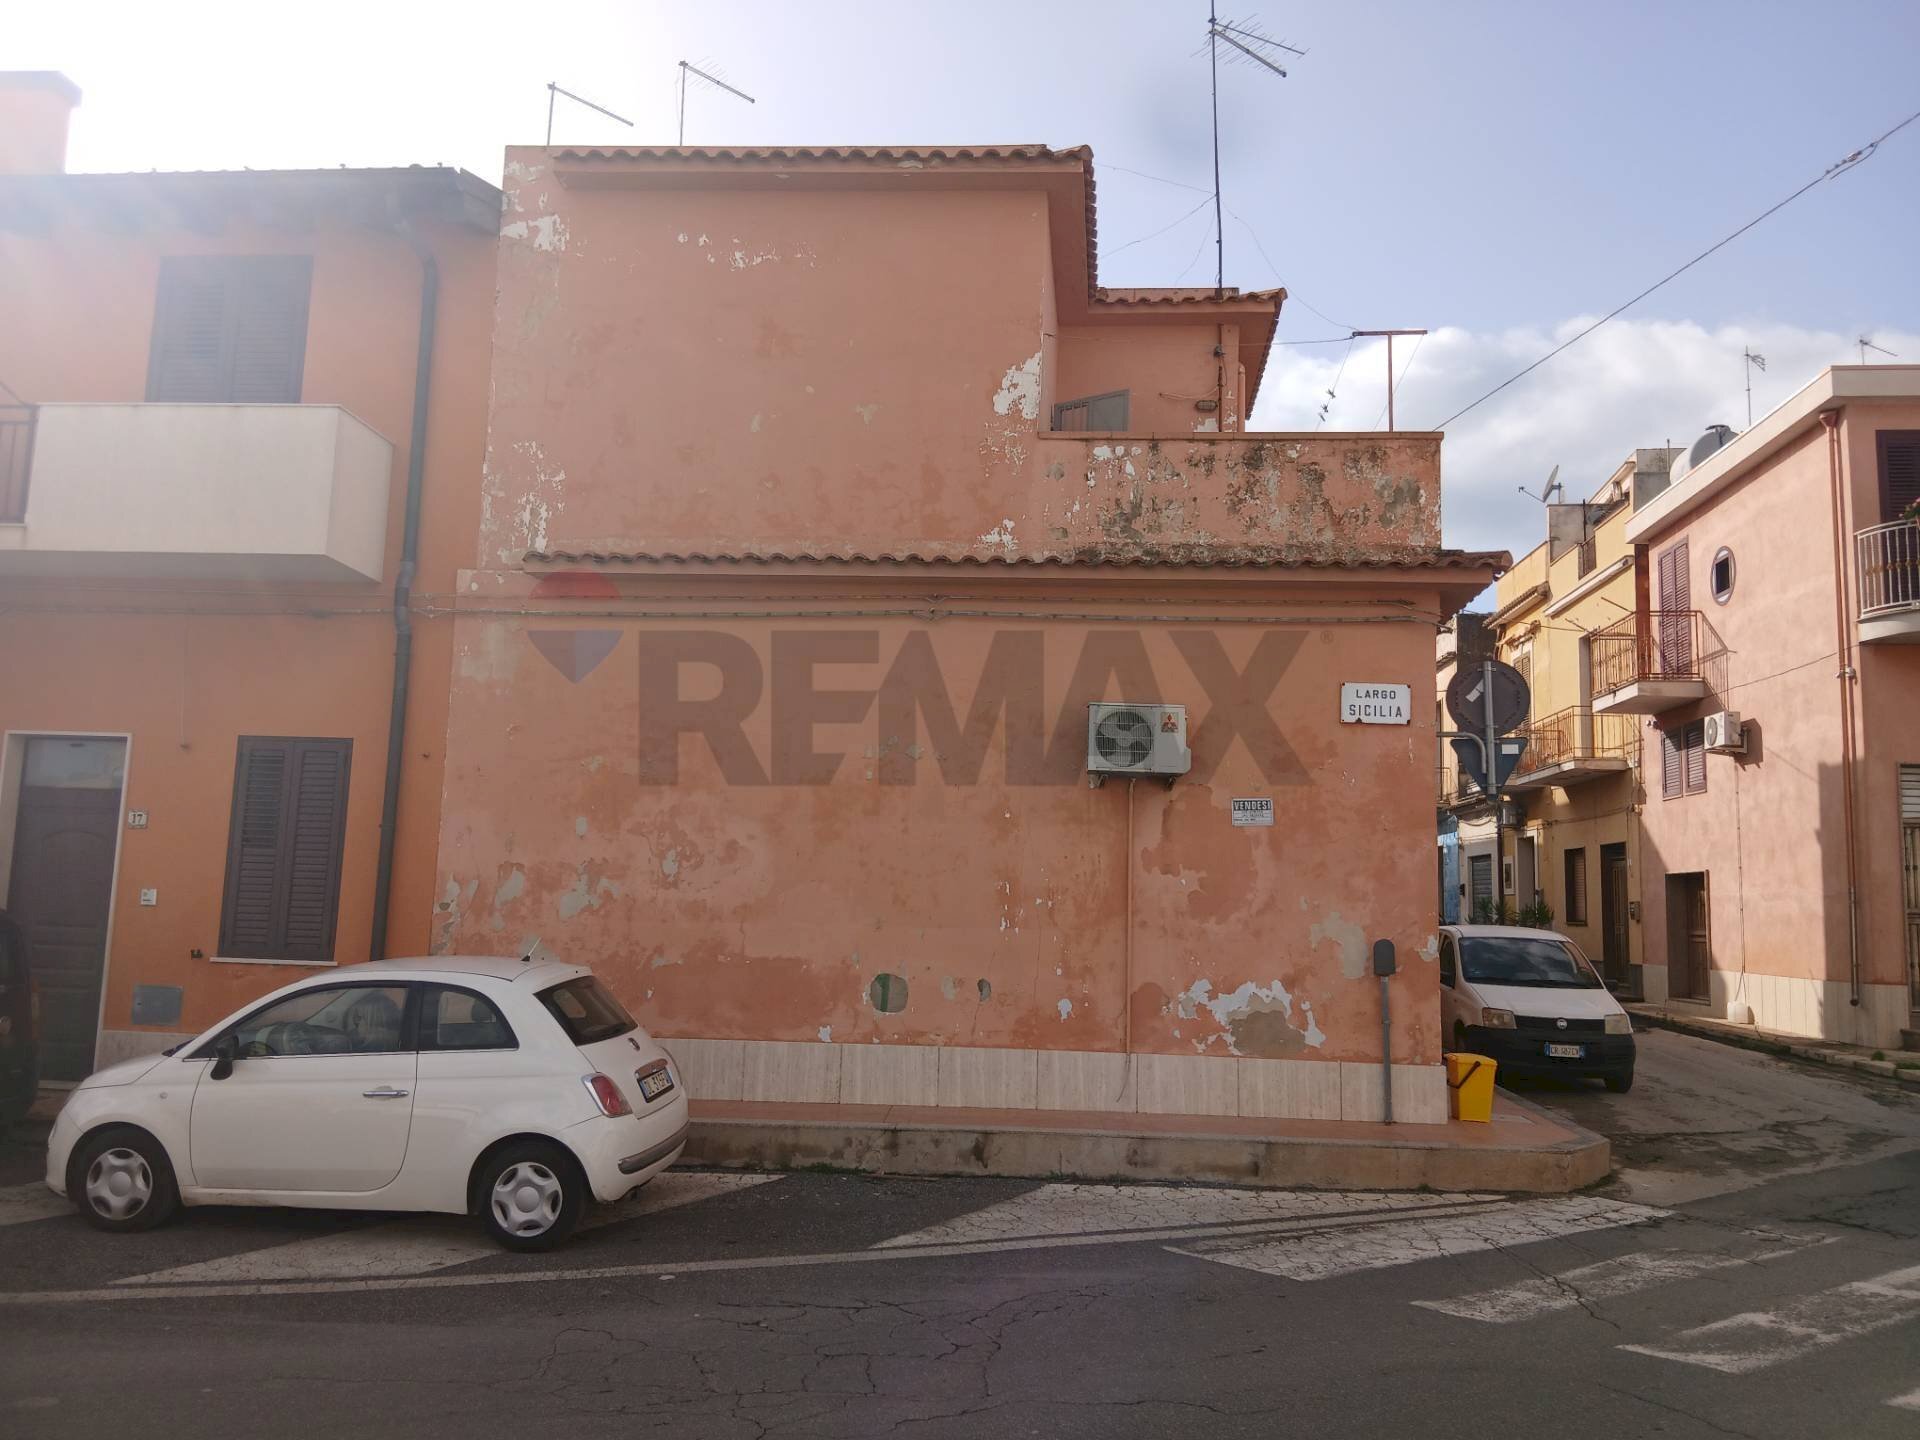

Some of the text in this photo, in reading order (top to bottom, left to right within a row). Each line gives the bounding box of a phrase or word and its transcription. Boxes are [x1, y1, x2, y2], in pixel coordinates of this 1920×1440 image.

[1356, 689, 1396, 699] LARGO
[1349, 704, 1402, 717] SICILIA
[1235, 801, 1271, 810] VENDESI
[132, 813, 143, 824] 17
